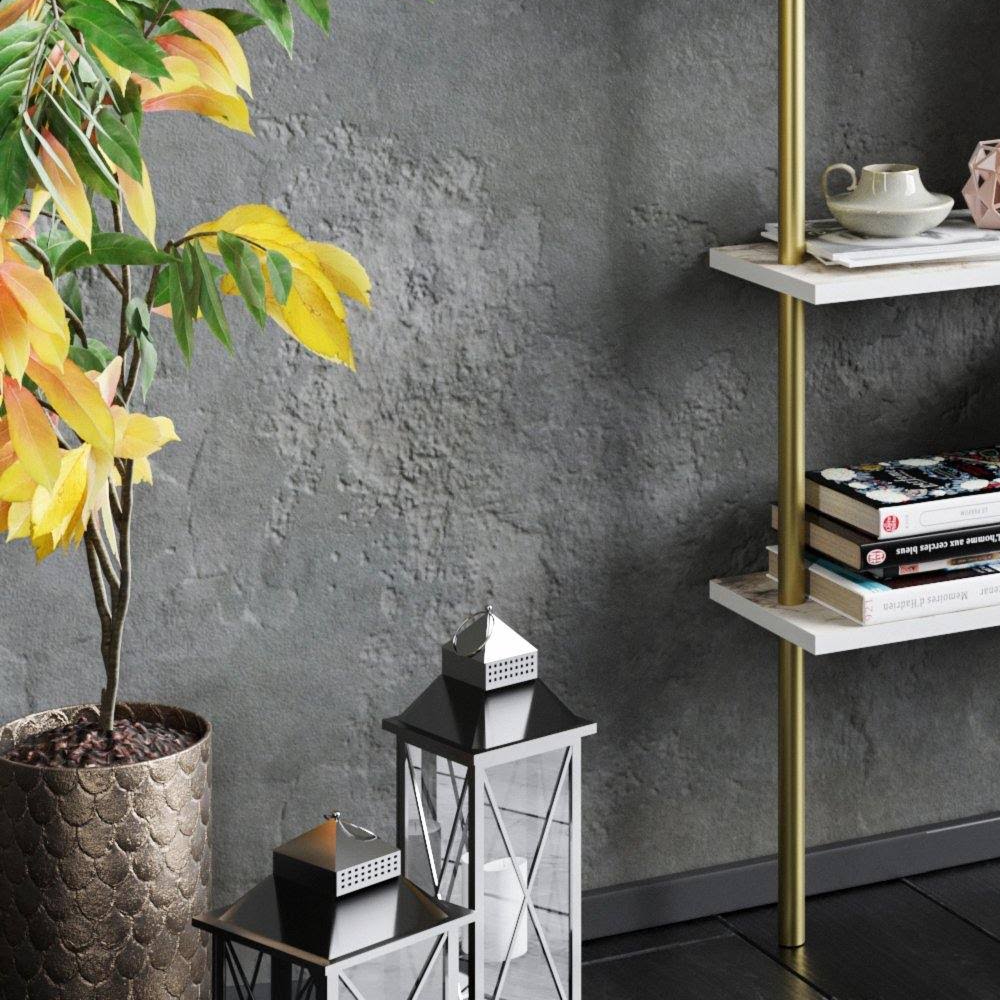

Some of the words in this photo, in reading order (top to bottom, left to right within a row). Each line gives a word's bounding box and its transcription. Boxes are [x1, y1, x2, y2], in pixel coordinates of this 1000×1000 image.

[920, 540, 948, 553] cercles
[949, 538, 965, 548] aux
[896, 545, 918, 556] bleus
